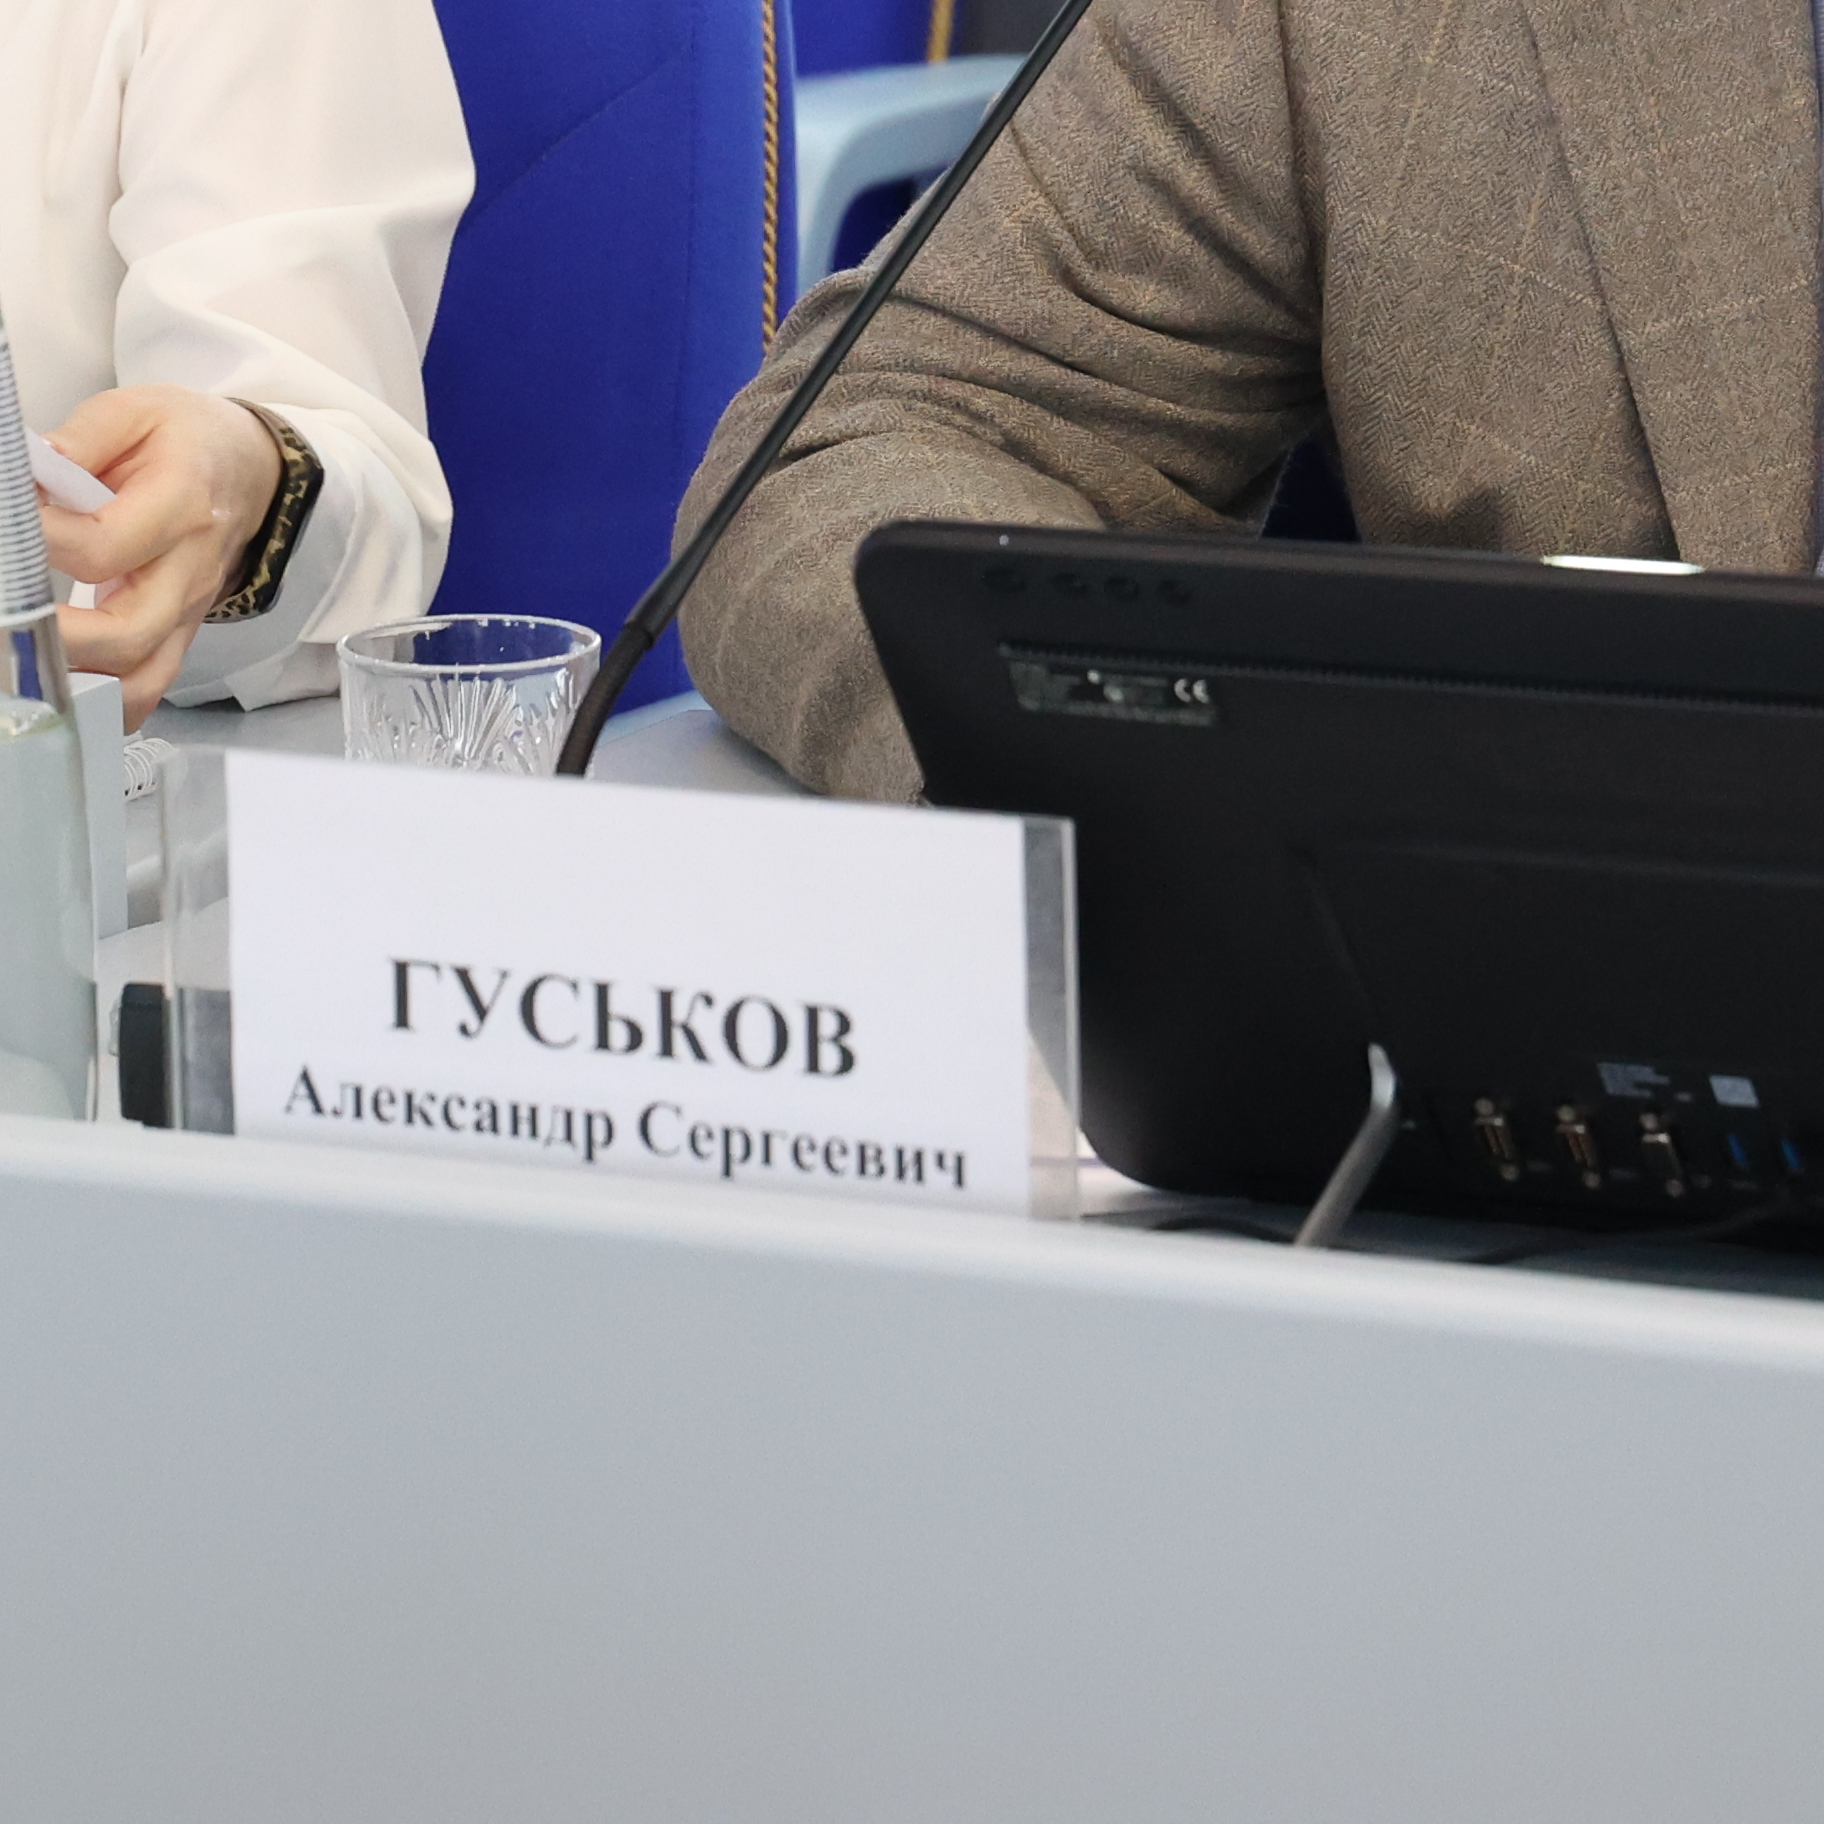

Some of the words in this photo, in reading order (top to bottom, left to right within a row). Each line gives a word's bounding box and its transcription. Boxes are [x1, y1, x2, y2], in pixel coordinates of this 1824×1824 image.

[387, 958, 857, 1079] ГУСЬКОВ
[284, 1065, 616, 1166] Александр
[638, 1101, 967, 1190] Сергеевич
